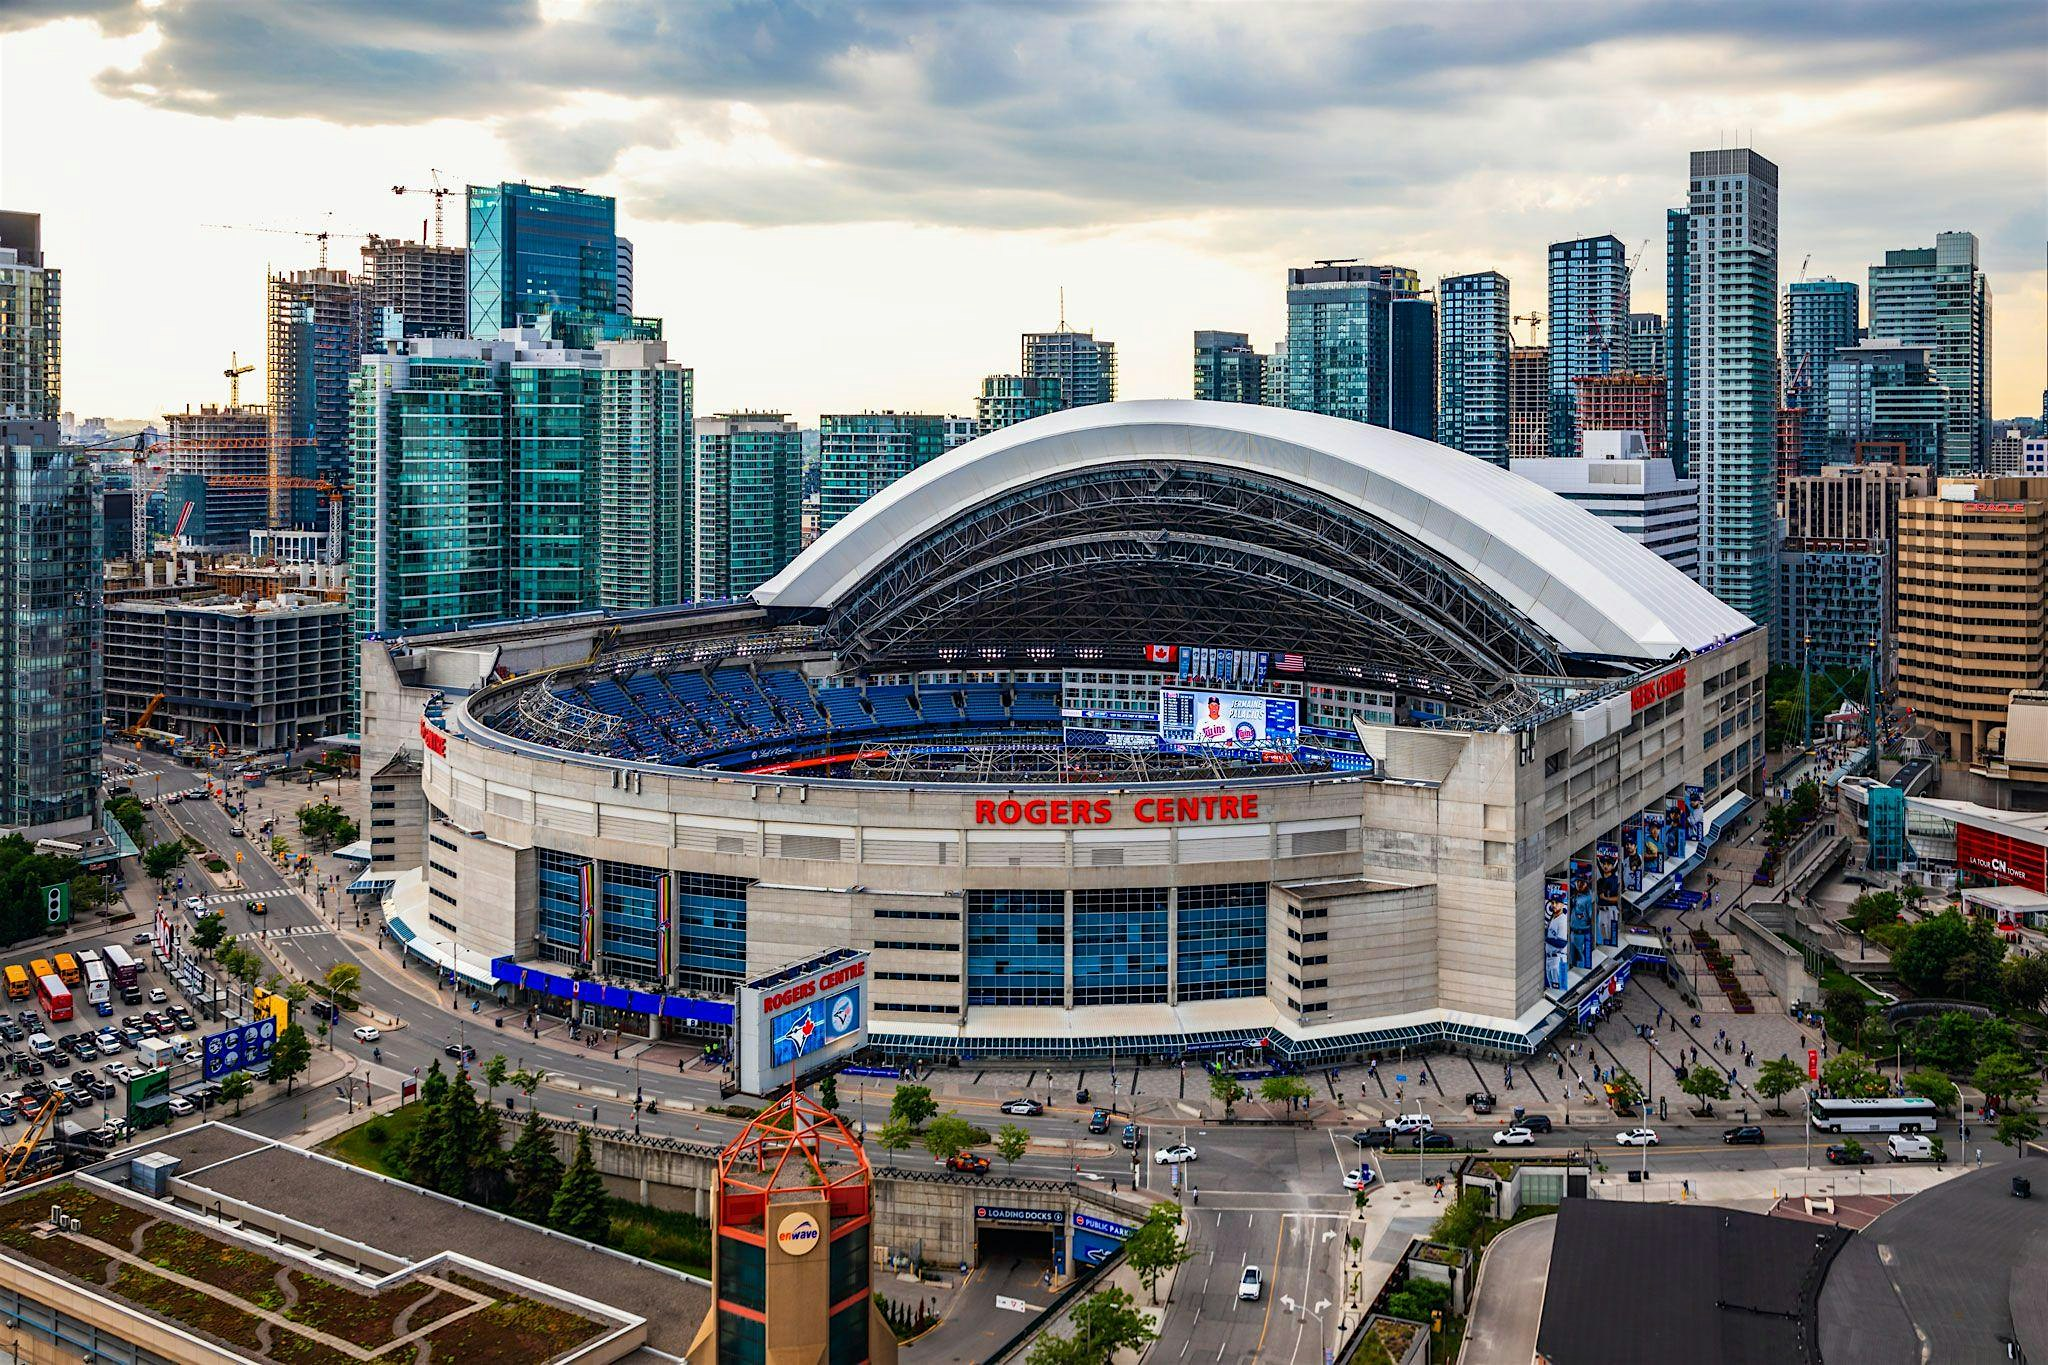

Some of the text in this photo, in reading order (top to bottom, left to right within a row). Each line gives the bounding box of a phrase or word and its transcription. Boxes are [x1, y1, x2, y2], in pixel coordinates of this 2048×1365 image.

[1963, 502, 2025, 512] ORACLE
[1657, 666, 1686, 700] CENTRE
[975, 794, 1258, 824] ROGERS CENTRE
[1977, 858, 1991, 869] TOUR
[1991, 858, 2006, 873] CN
[2007, 867, 2026, 879] TOWER
[763, 961, 865, 1014] ROGERS CENTRE
[988, 1209, 1052, 1221] LOADING DOCKS
[1085, 1219, 1108, 1231] PUBLIC
[779, 1230, 818, 1241] enwave
